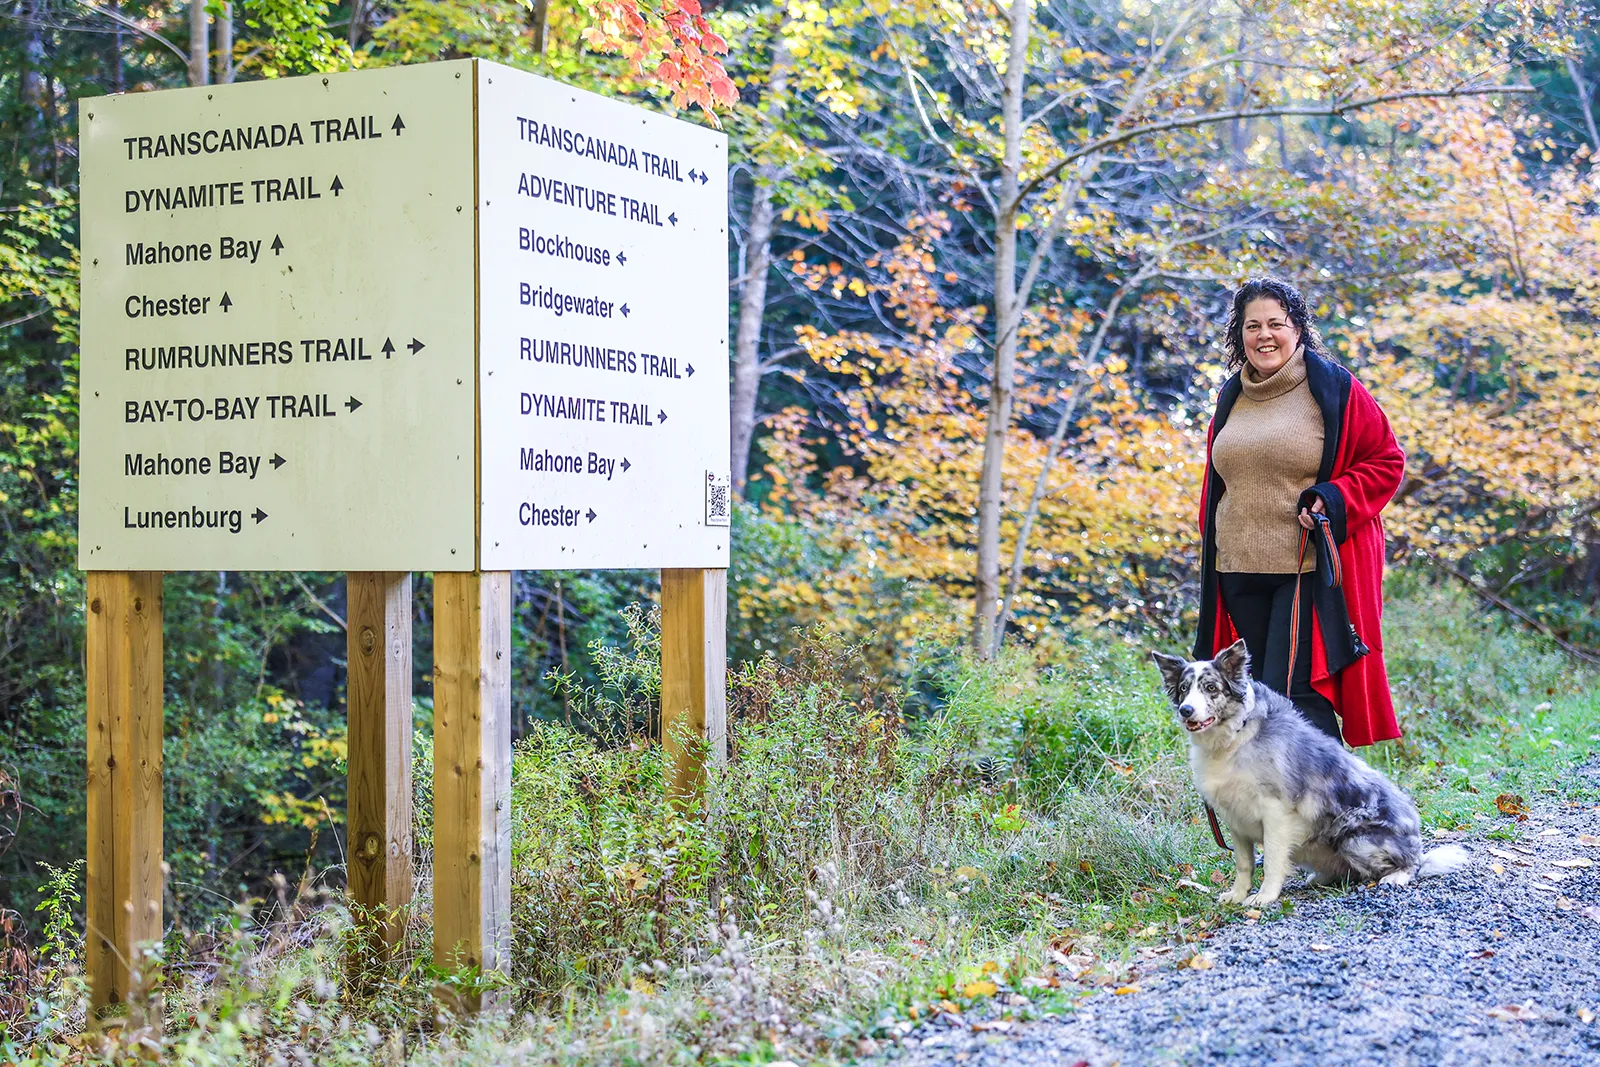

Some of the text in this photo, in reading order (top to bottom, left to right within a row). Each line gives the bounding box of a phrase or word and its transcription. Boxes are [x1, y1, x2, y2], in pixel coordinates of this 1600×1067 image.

[123, 116, 382, 161] TRANSCANADA TRAIL
[516, 116, 684, 183] TRANSCANADA TRAIL
[125, 176, 321, 213] DYNAMITE TRAIL
[518, 172, 663, 227] ADVENTURE TRAIL
[126, 237, 261, 265] Mahone Bay
[519, 228, 611, 267] Blockhouse
[125, 293, 211, 318] Chester
[520, 282, 614, 319] Bridgewater
[125, 338, 372, 370] RUMRUNNERS TRAIL
[520, 337, 682, 379] RUMRUNNERS TRAIL
[125, 394, 337, 423] BAY-TO-BAY TRAIL
[520, 393, 653, 426] DYNAMITE TRAIL
[125, 452, 261, 480] Mahone Bay
[520, 447, 615, 481] Mahone Bay
[125, 506, 242, 533] Lunenburg
[519, 502, 581, 527] Chester
